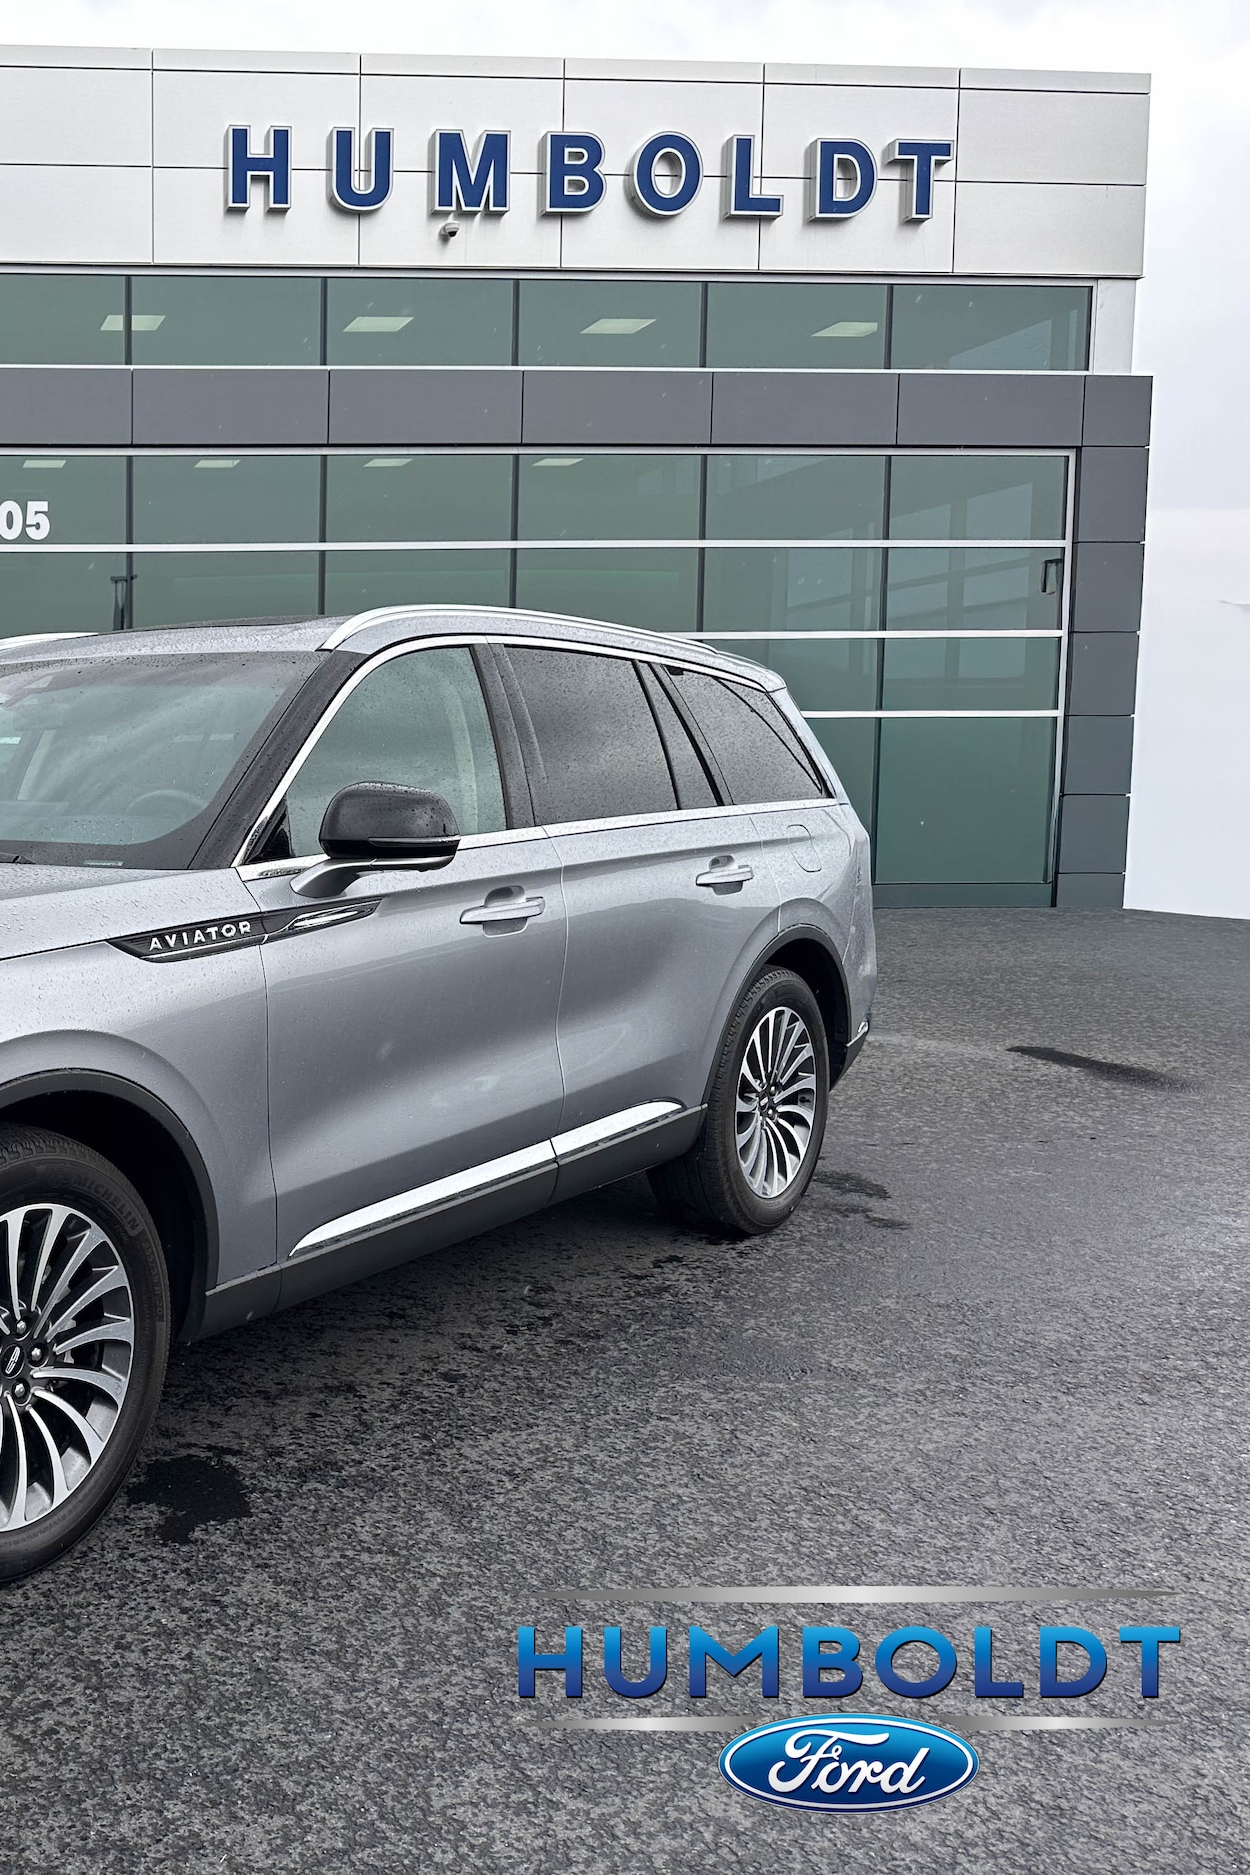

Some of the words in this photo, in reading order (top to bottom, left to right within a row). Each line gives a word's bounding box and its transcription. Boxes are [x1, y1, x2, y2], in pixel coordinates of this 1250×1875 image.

[222, 124, 954, 221] HUMBOLDT
[149, 921, 251, 951] AVIATOR
[73, 1174, 140, 1232] MICHELIN
